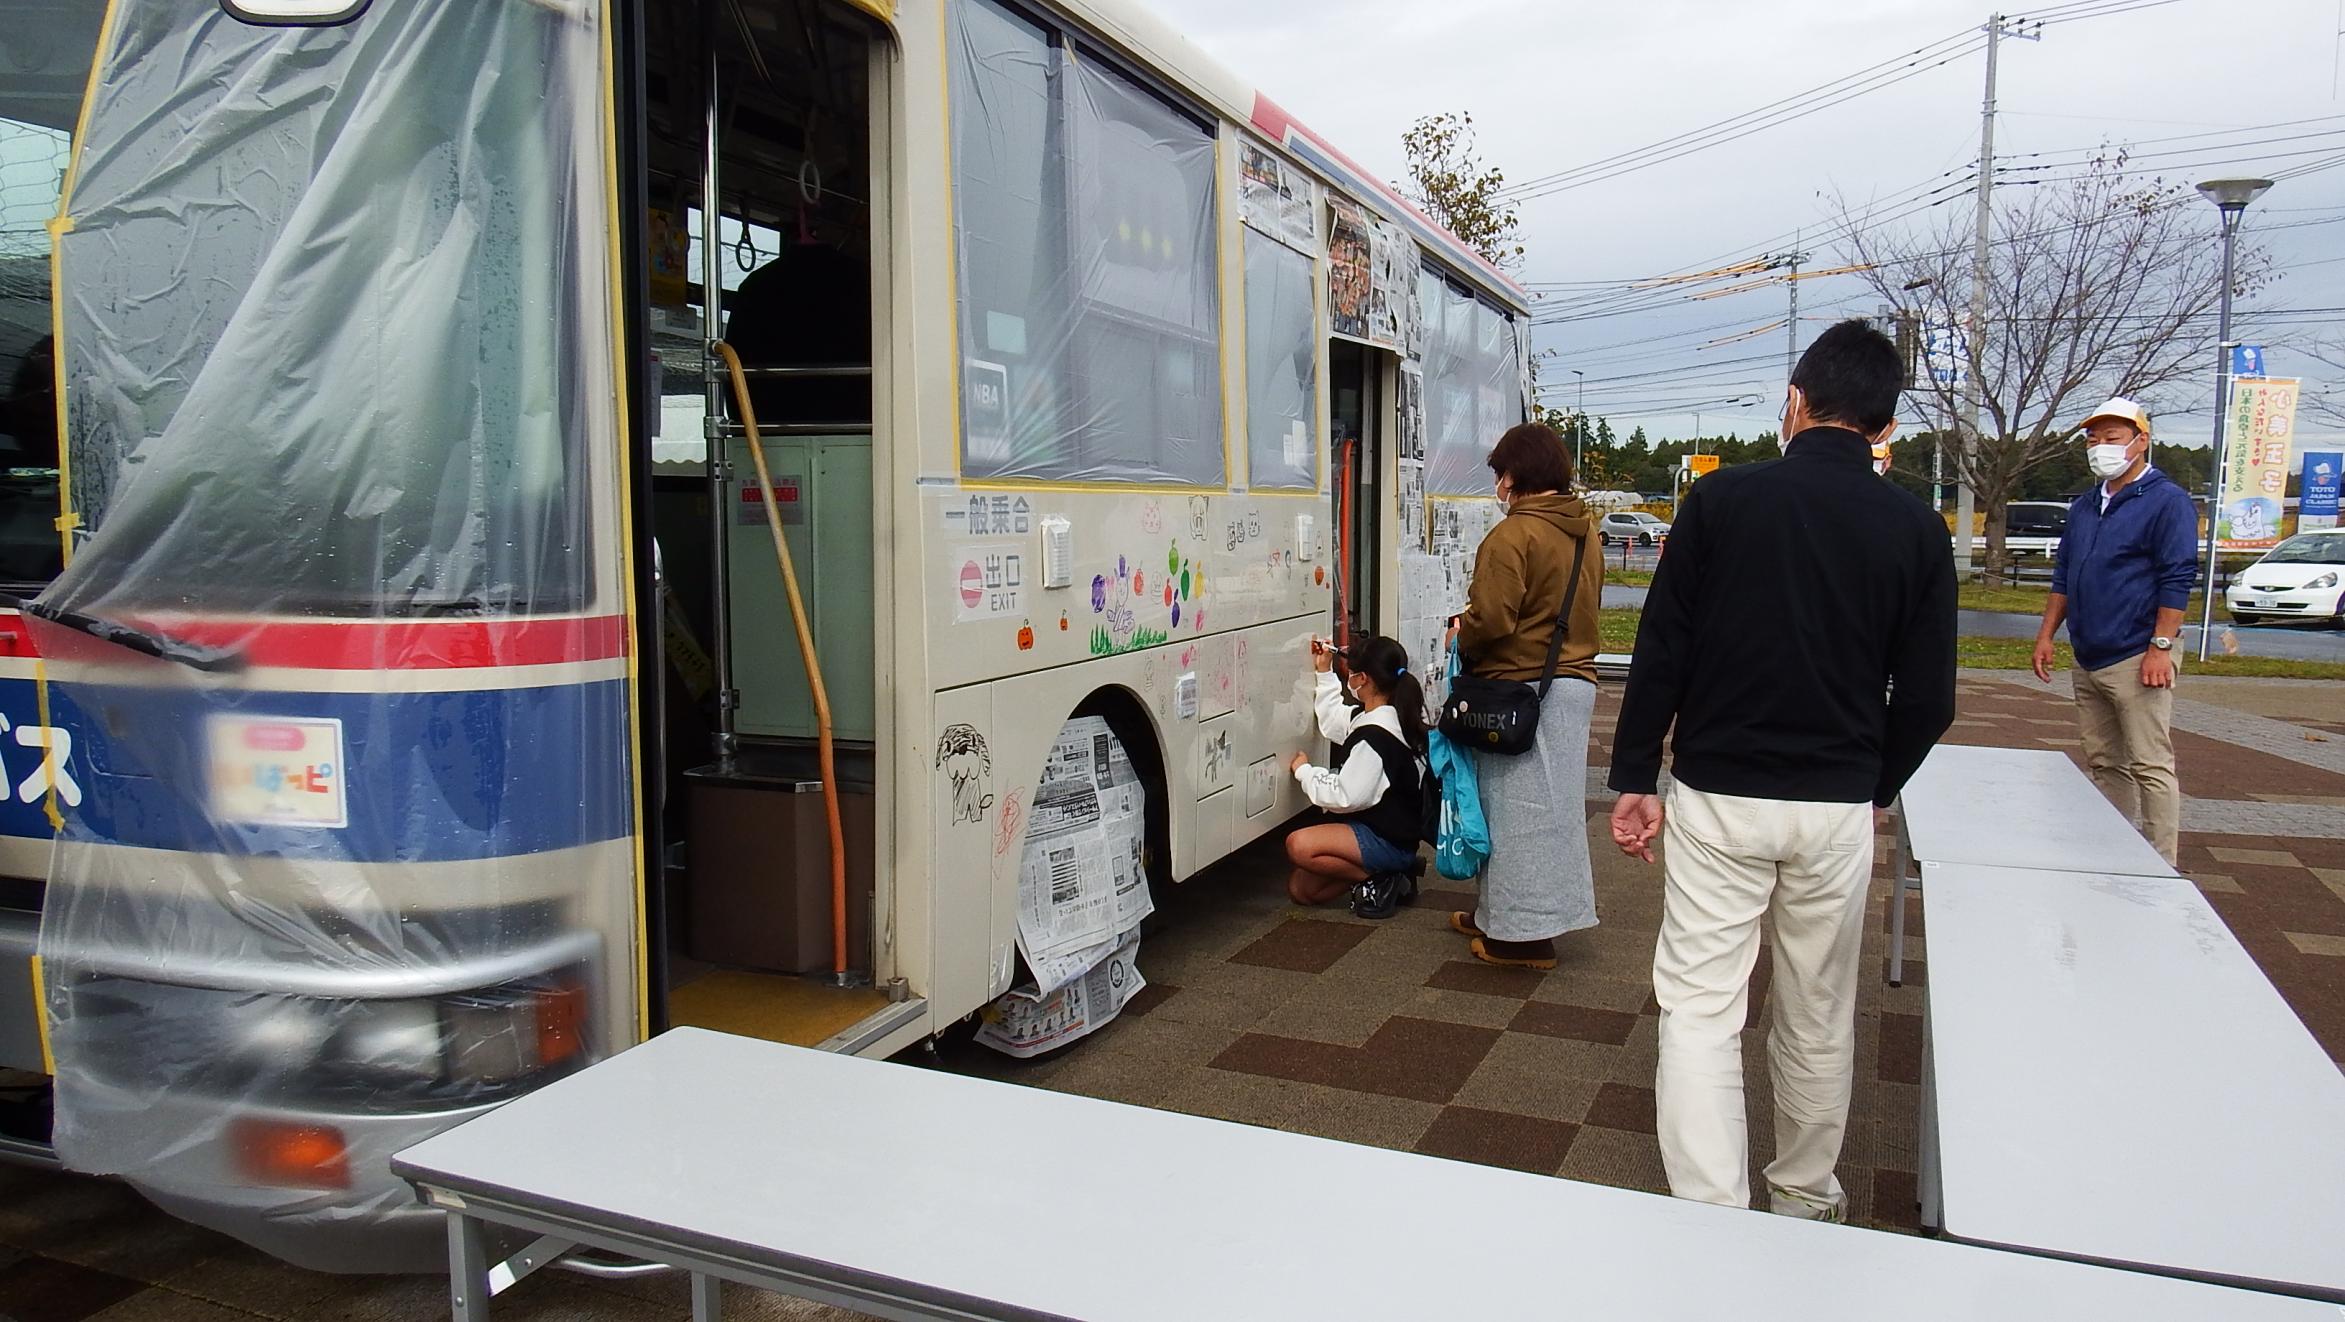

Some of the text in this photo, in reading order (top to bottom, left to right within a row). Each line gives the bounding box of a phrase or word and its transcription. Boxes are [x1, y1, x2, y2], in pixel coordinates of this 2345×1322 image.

[945, 494, 1030, 535] 一般乗合
[986, 553, 1020, 588] 出口
[991, 592, 1017, 611] EXIT
[1462, 712, 1506, 730] YONEX
